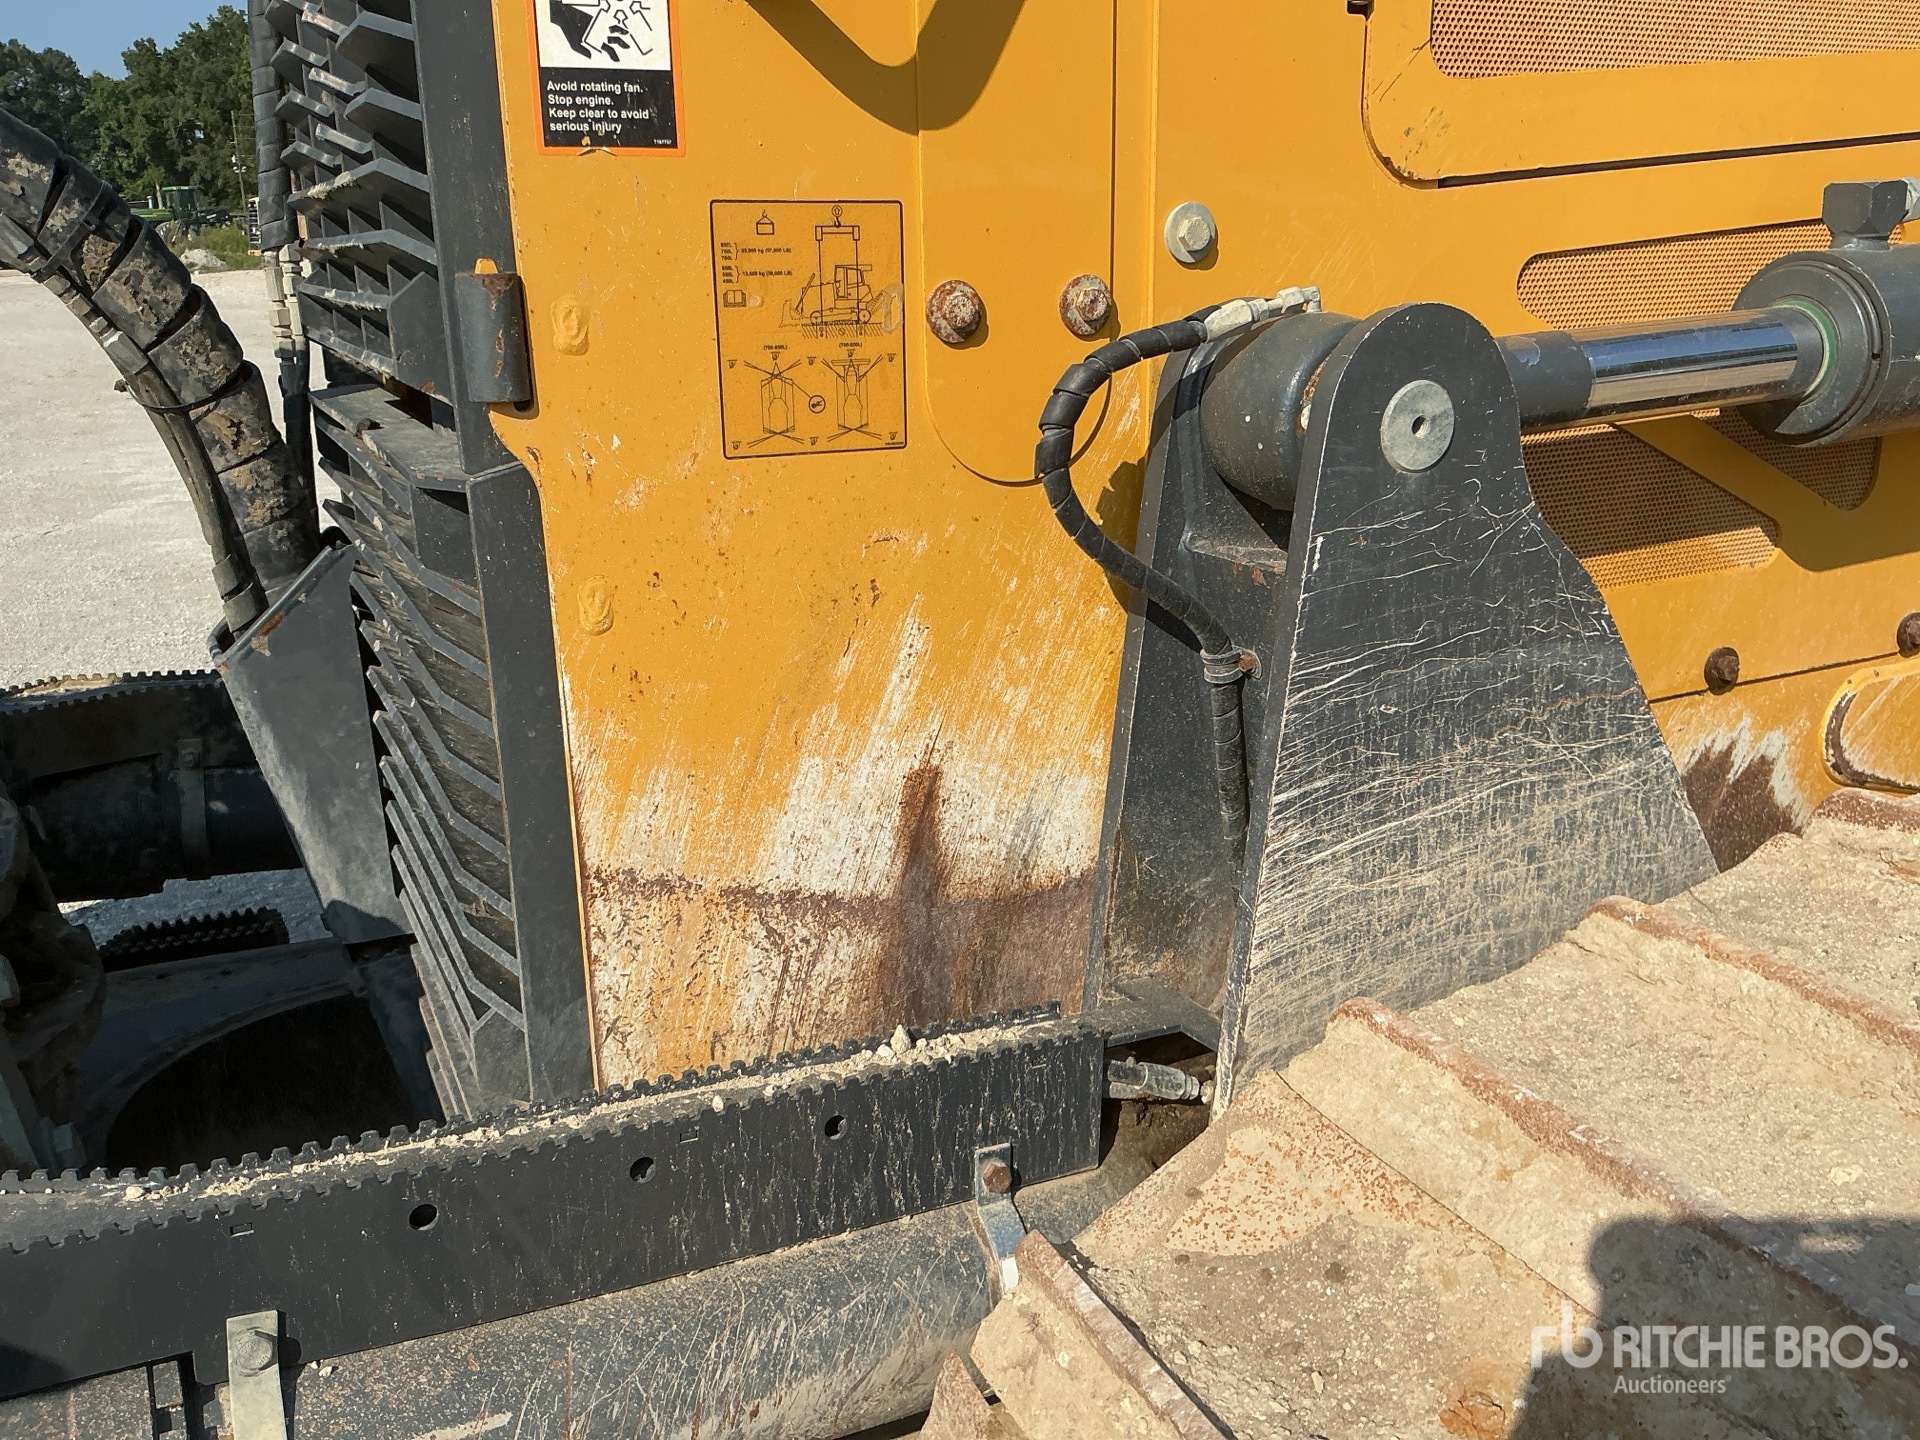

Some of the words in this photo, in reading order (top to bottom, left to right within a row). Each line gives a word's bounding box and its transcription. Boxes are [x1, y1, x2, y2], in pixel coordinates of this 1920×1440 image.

[547, 80, 578, 91] Avoid
[580, 81, 621, 94] rotating
[624, 82, 644, 93] fan.
[548, 94, 573, 106] Stop
[575, 95, 614, 107] engine.
[549, 107, 576, 120] Keep
[579, 108, 605, 119] clear
[607, 109, 618, 119] to
[621, 109, 649, 119] avoid
[550, 122, 590, 132] serious
[592, 122, 622, 134] injury
